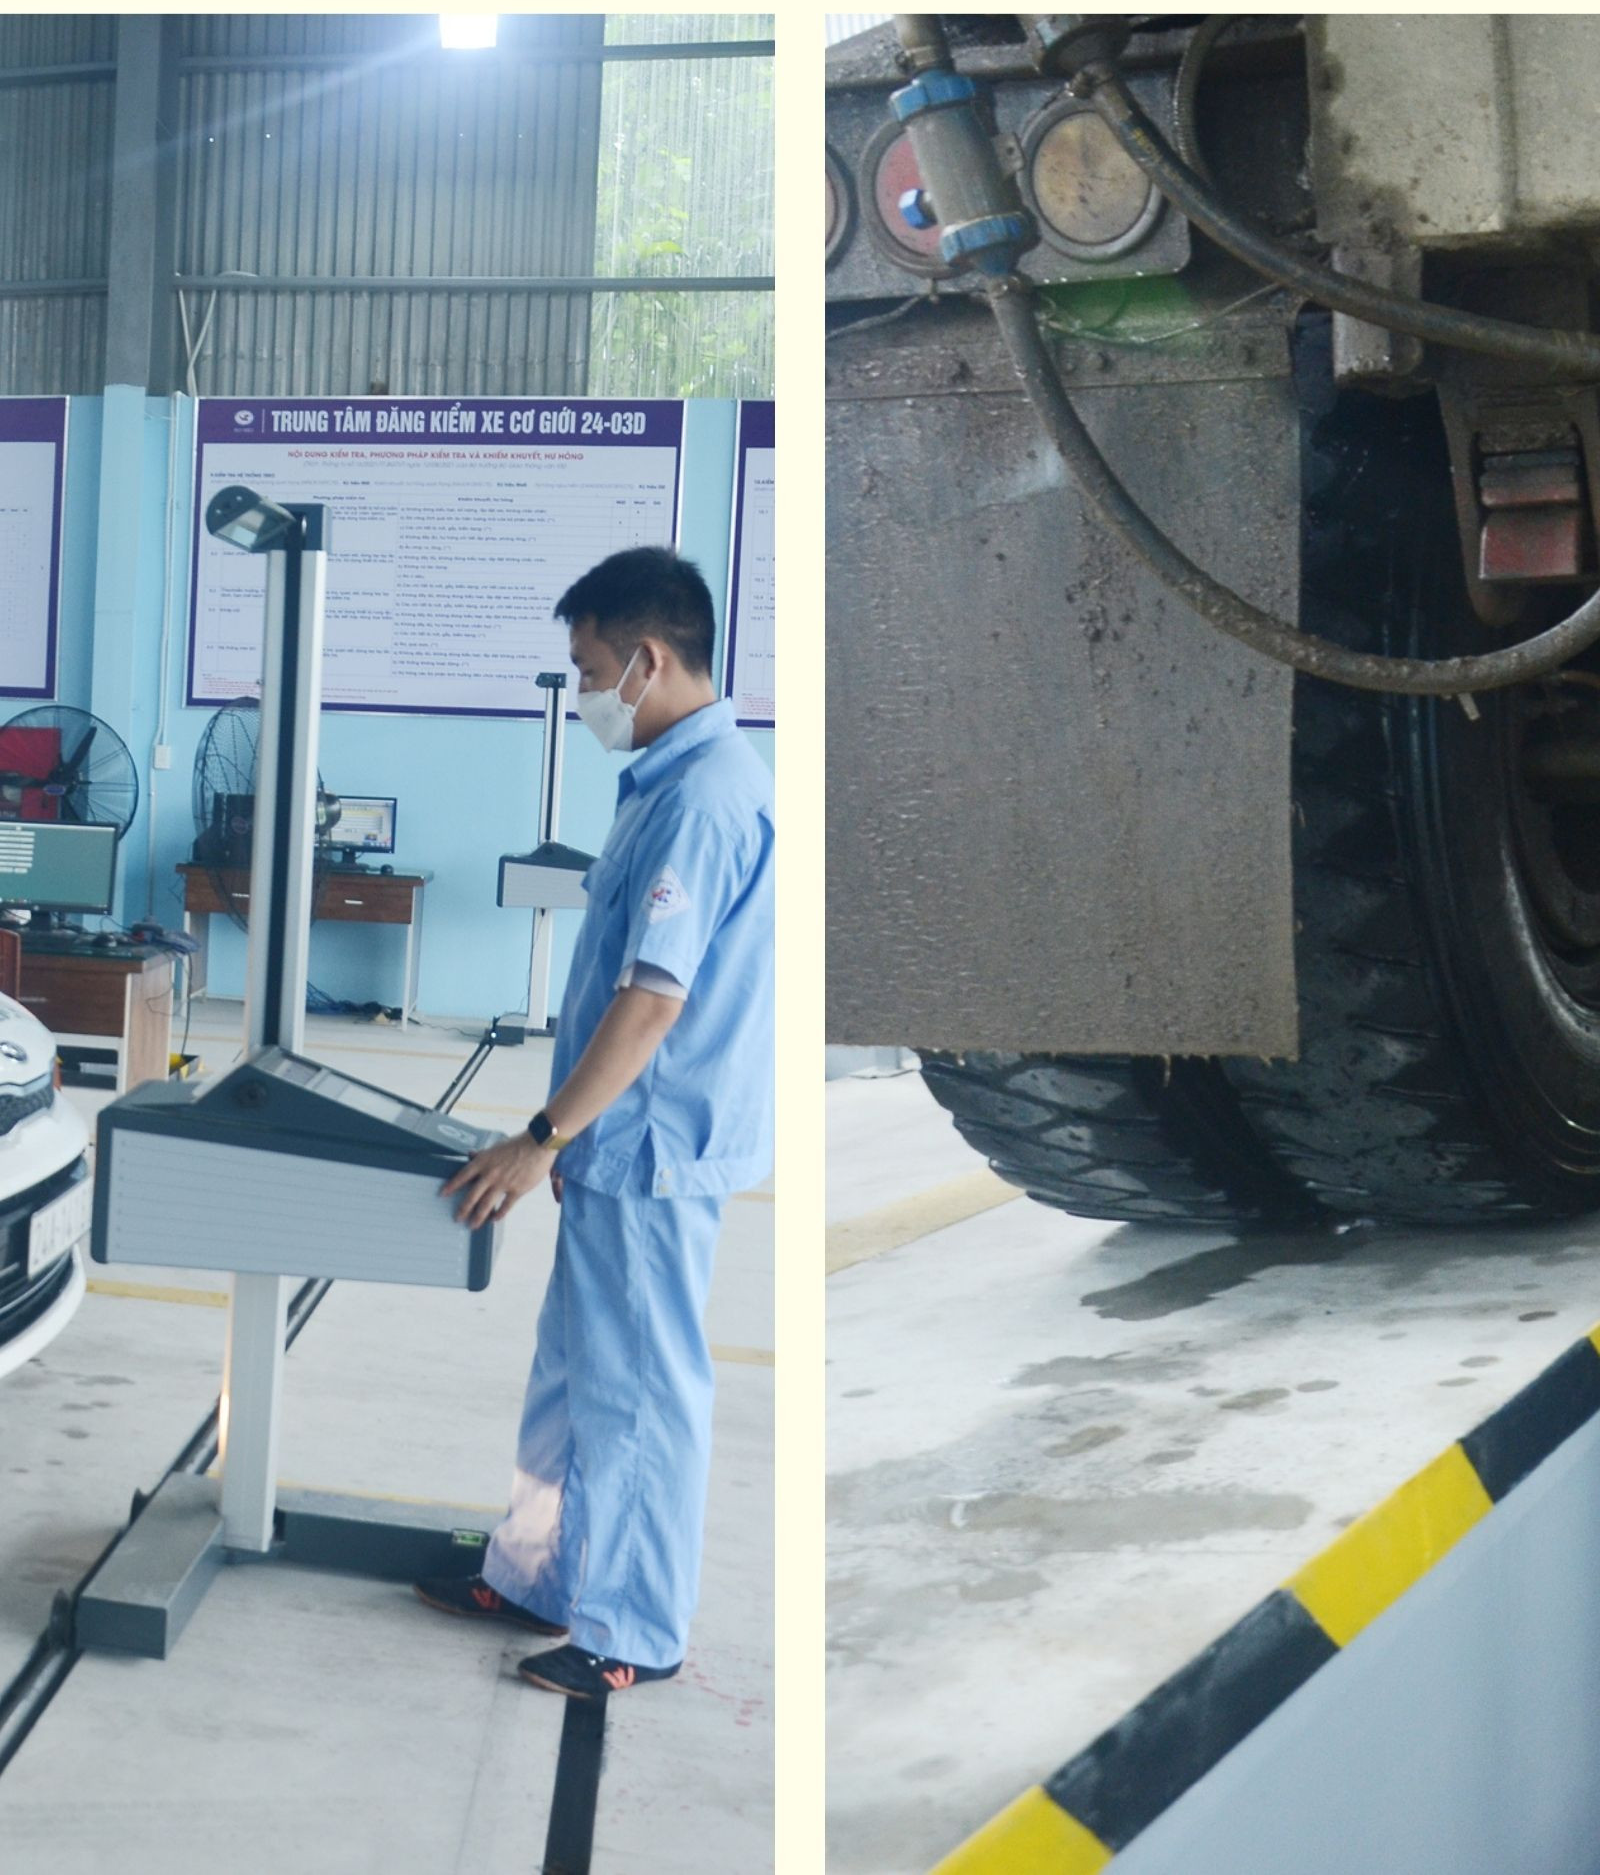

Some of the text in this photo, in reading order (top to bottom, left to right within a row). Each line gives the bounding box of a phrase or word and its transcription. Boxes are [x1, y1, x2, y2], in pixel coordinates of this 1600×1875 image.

[272, 402, 647, 436] TRUNG TÂM ĐĂNG KIỂM XE CƠ GIỚI 24-03D
